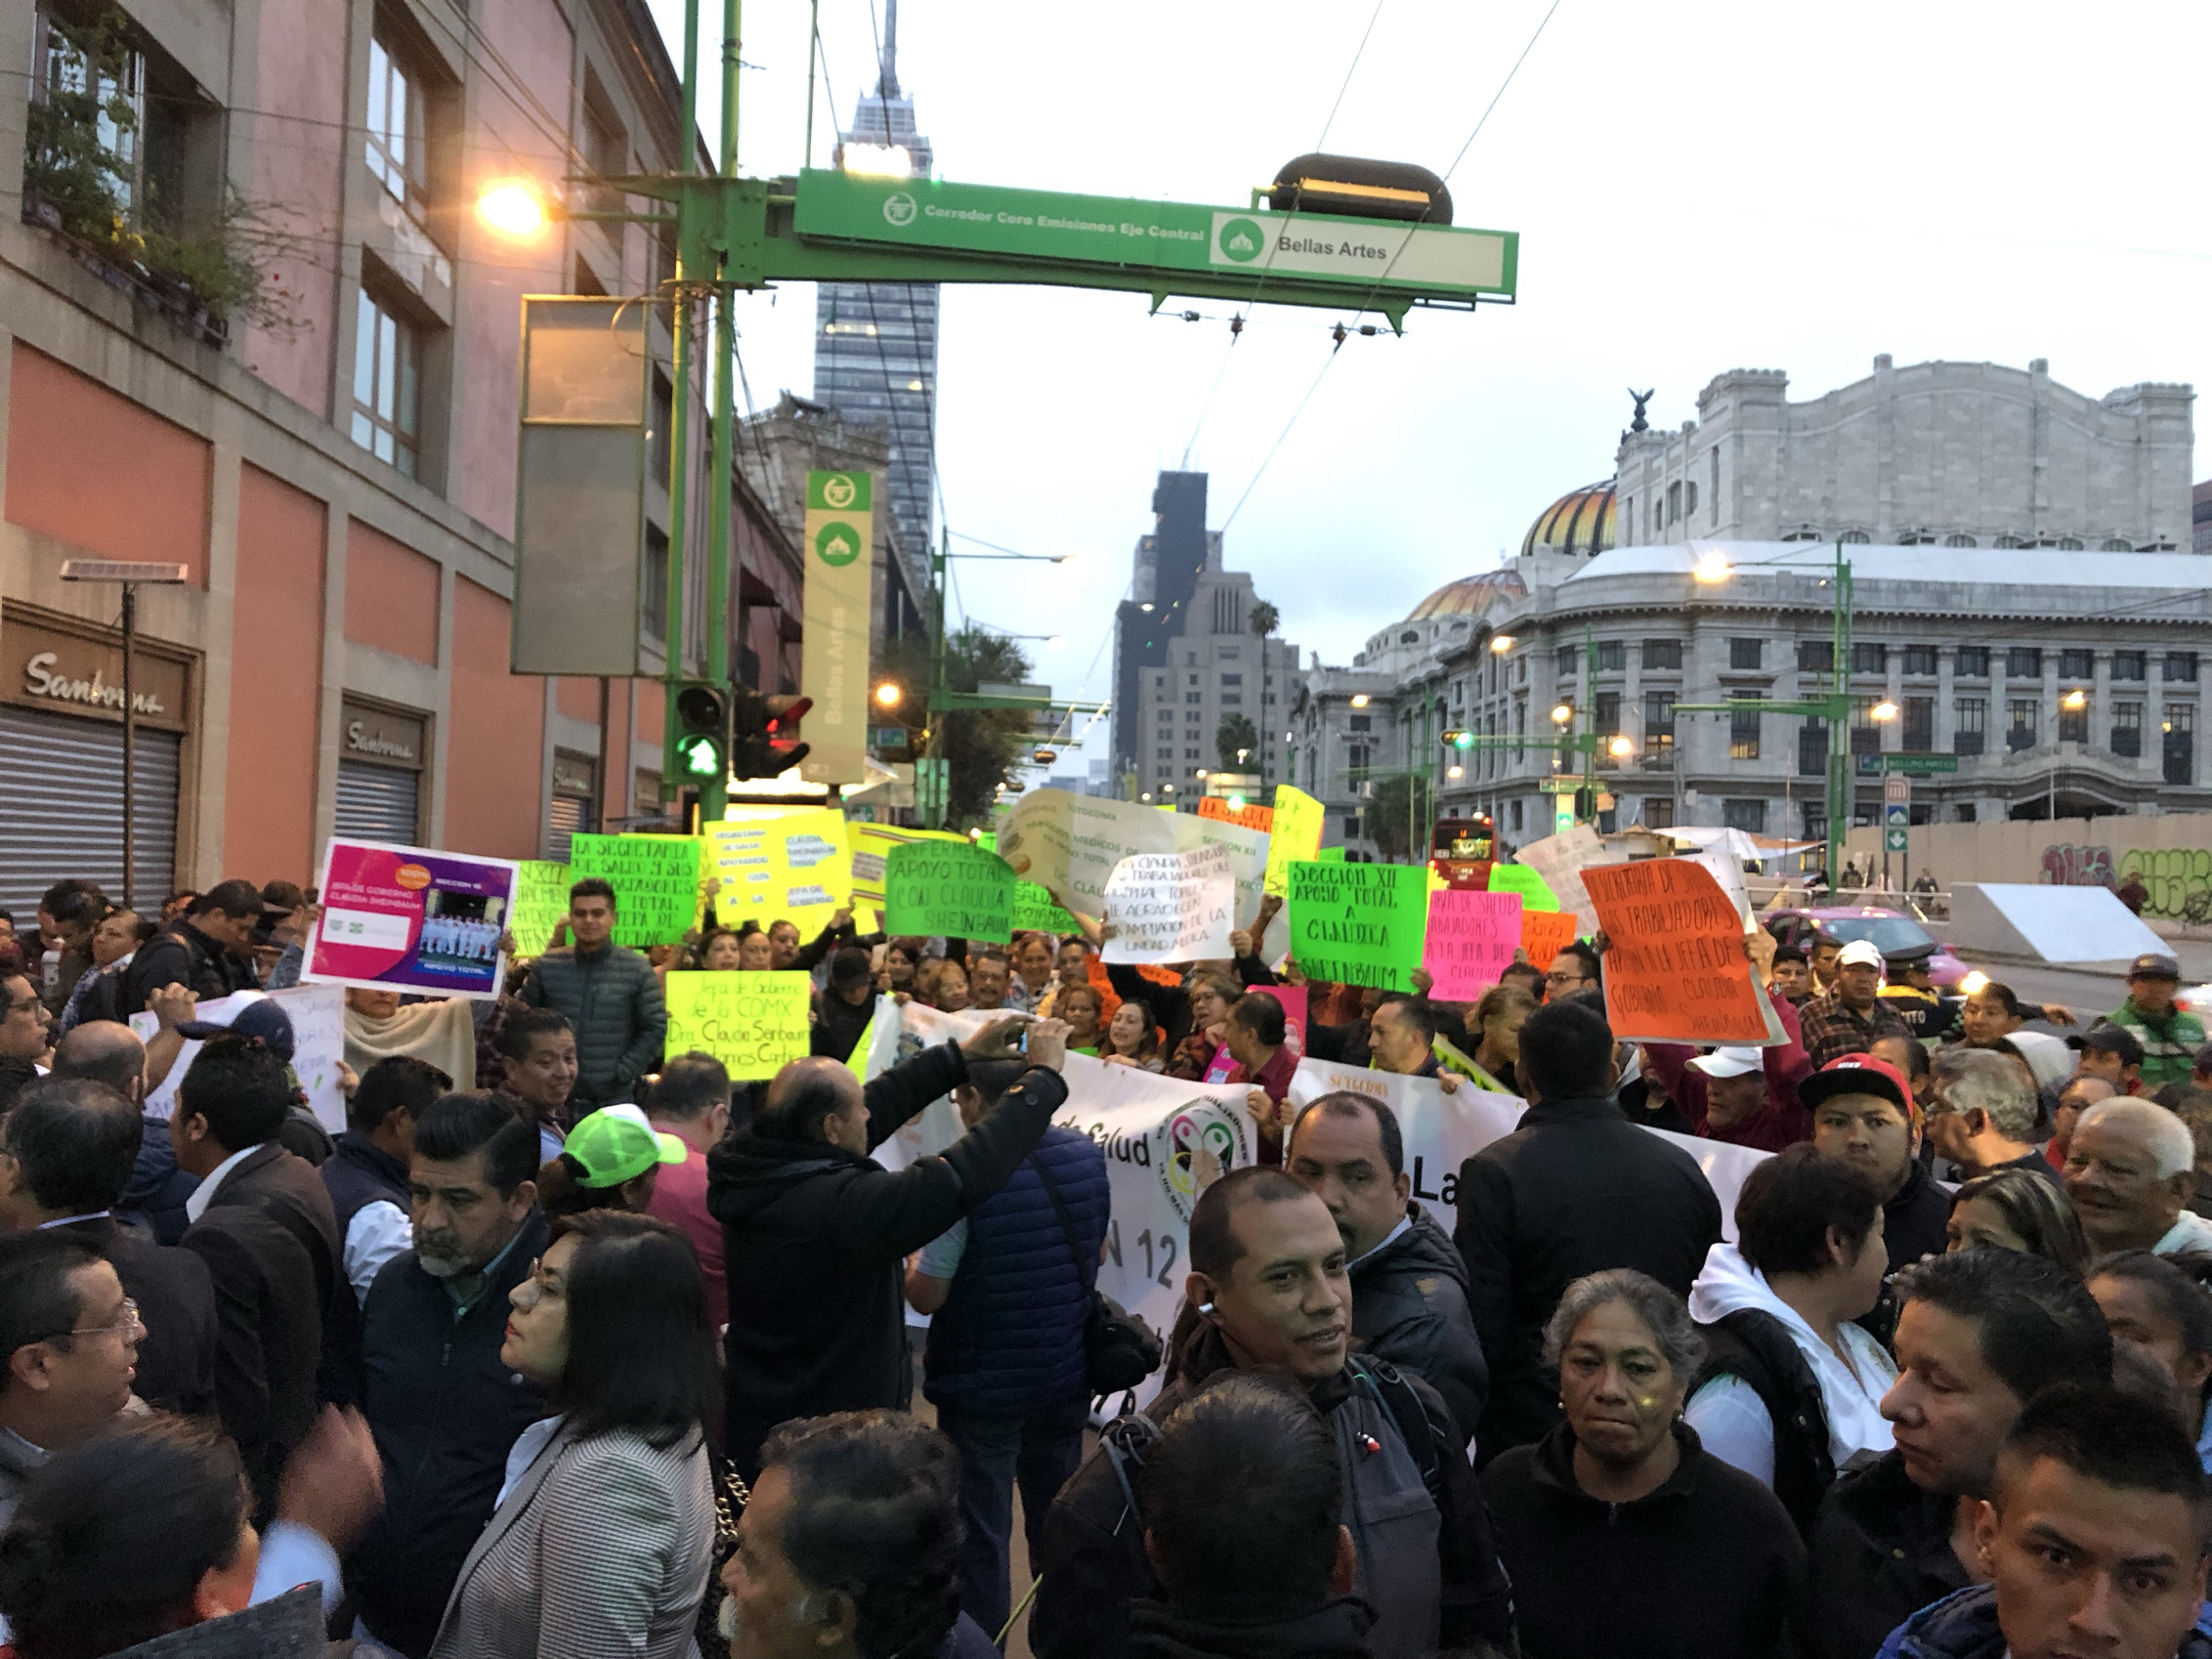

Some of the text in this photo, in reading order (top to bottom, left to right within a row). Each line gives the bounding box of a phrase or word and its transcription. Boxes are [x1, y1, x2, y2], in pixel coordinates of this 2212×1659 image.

[924, 204, 1205, 241] Corredor Cero Emisiones Eje Central
[1278, 236, 1386, 260] Bellas Artes
[786, 835, 823, 845] CLAUDIA
[719, 856, 769, 867] APOYANDO
[1084, 852, 1110, 867] TOTAL
[893, 860, 951, 879] APOYO
[955, 861, 1008, 885] TOTAL
[1377, 867, 1397, 889] XII
[1658, 863, 1676, 894] DE
[897, 882, 1004, 910] CON CLAUDIA
[1014, 888, 1049, 906] SALU
[1074, 880, 1105, 898] CLAU
[730, 897, 738, 906] A
[1344, 905, 1356, 919] A
[1478, 894, 1517, 915] SALUD
[1209, 907, 1226, 922] LA
[1626, 896, 1734, 937] TRABAJADORES
[1306, 918, 1390, 948] CLAUDIA
[1429, 915, 1498, 939] ABAJADORES
[1440, 942, 1454, 960] LA
[1462, 942, 1482, 962] JEFA
[1493, 943, 1506, 962] DE
[1712, 935, 1736, 968] DE
[686, 996, 793, 1018] de la CDMX
[668, 1020, 694, 1042] Dra
[1087, 1122, 1152, 1168] Salud
[1163, 1177, 1172, 1194] NO
[1137, 1227, 1177, 1290] 12
